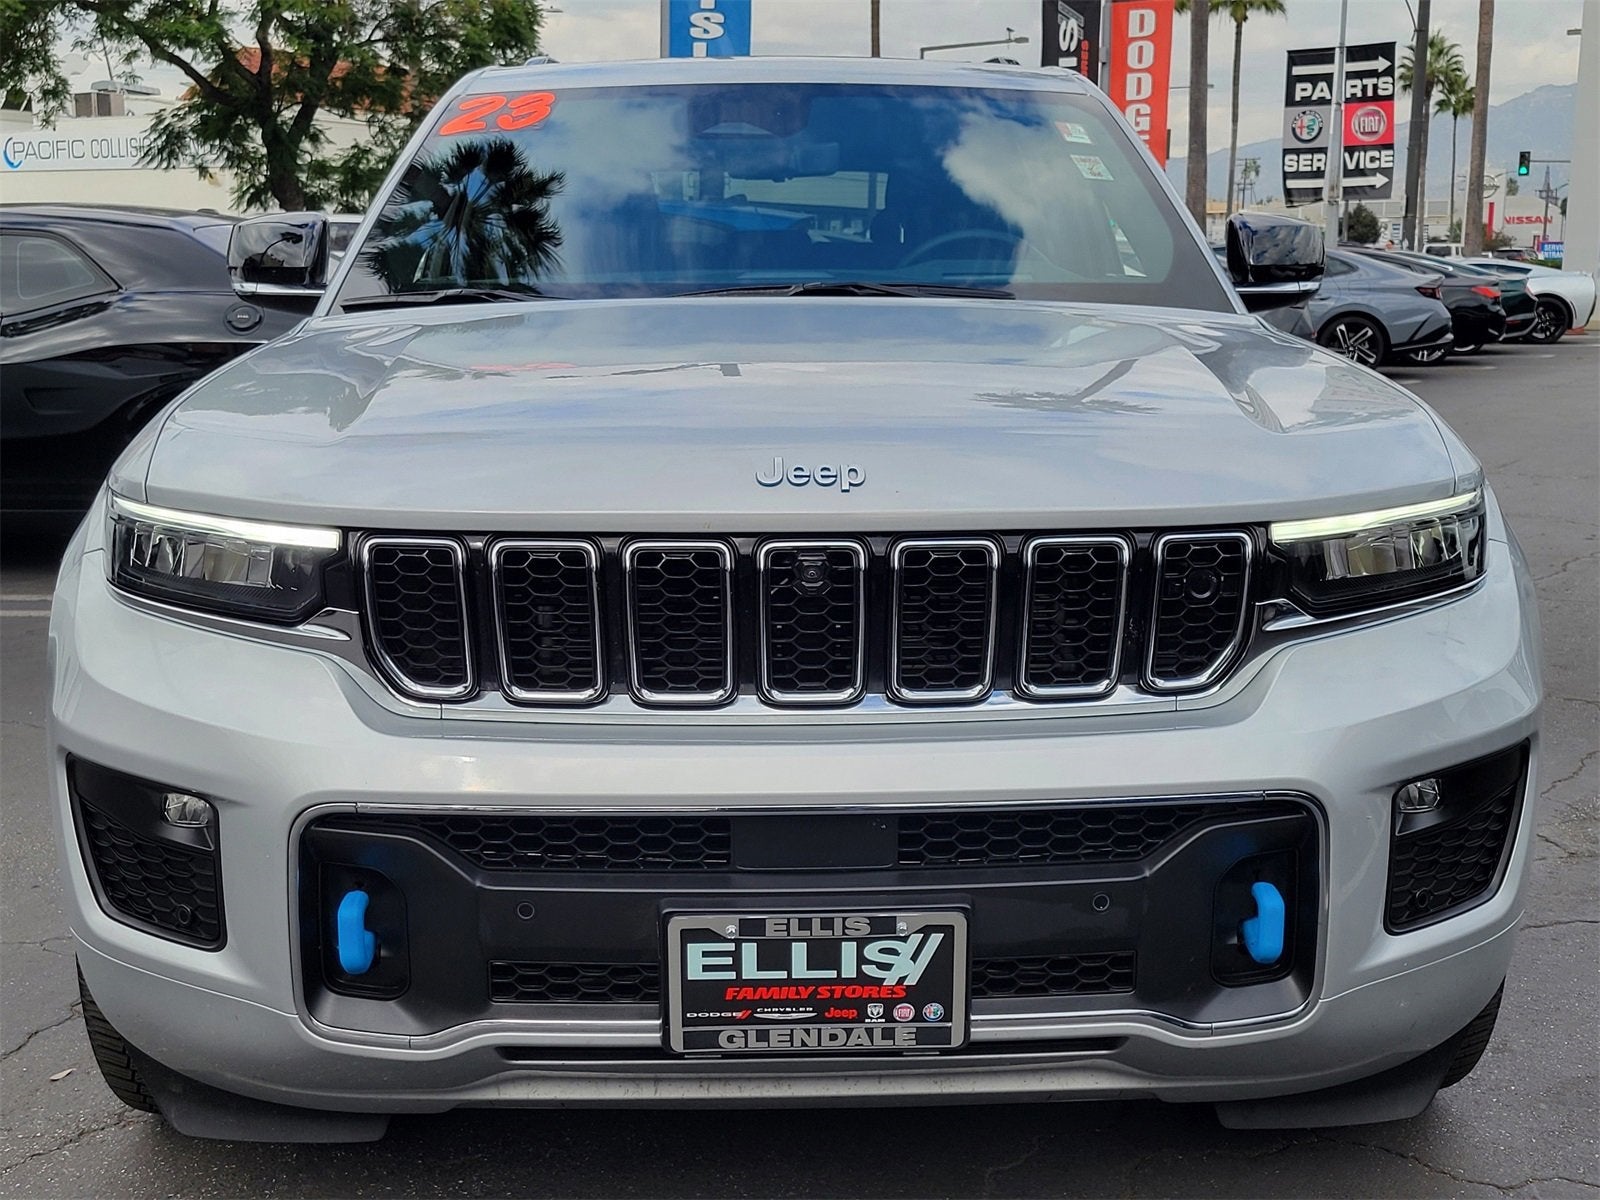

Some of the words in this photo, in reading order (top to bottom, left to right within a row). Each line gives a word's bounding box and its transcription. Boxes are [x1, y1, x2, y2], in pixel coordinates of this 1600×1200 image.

[1124, 9, 1156, 148] DODG
[1295, 77, 1393, 101] PARTS
[439, 92, 555, 136] 23
[1360, 116, 1380, 132] FIAT
[12, 139, 84, 160] PACIFIC
[1284, 150, 1394, 172] SERVICE
[1504, 216, 1553, 225] NISSAN
[755, 457, 867, 493] Jeep
[766, 917, 871, 937] ELLIS
[725, 986, 815, 1000] FAMILY
[816, 985, 907, 999] STORES
[824, 1007, 858, 1019] Jeep
[717, 1027, 917, 1050] GLENDALE
